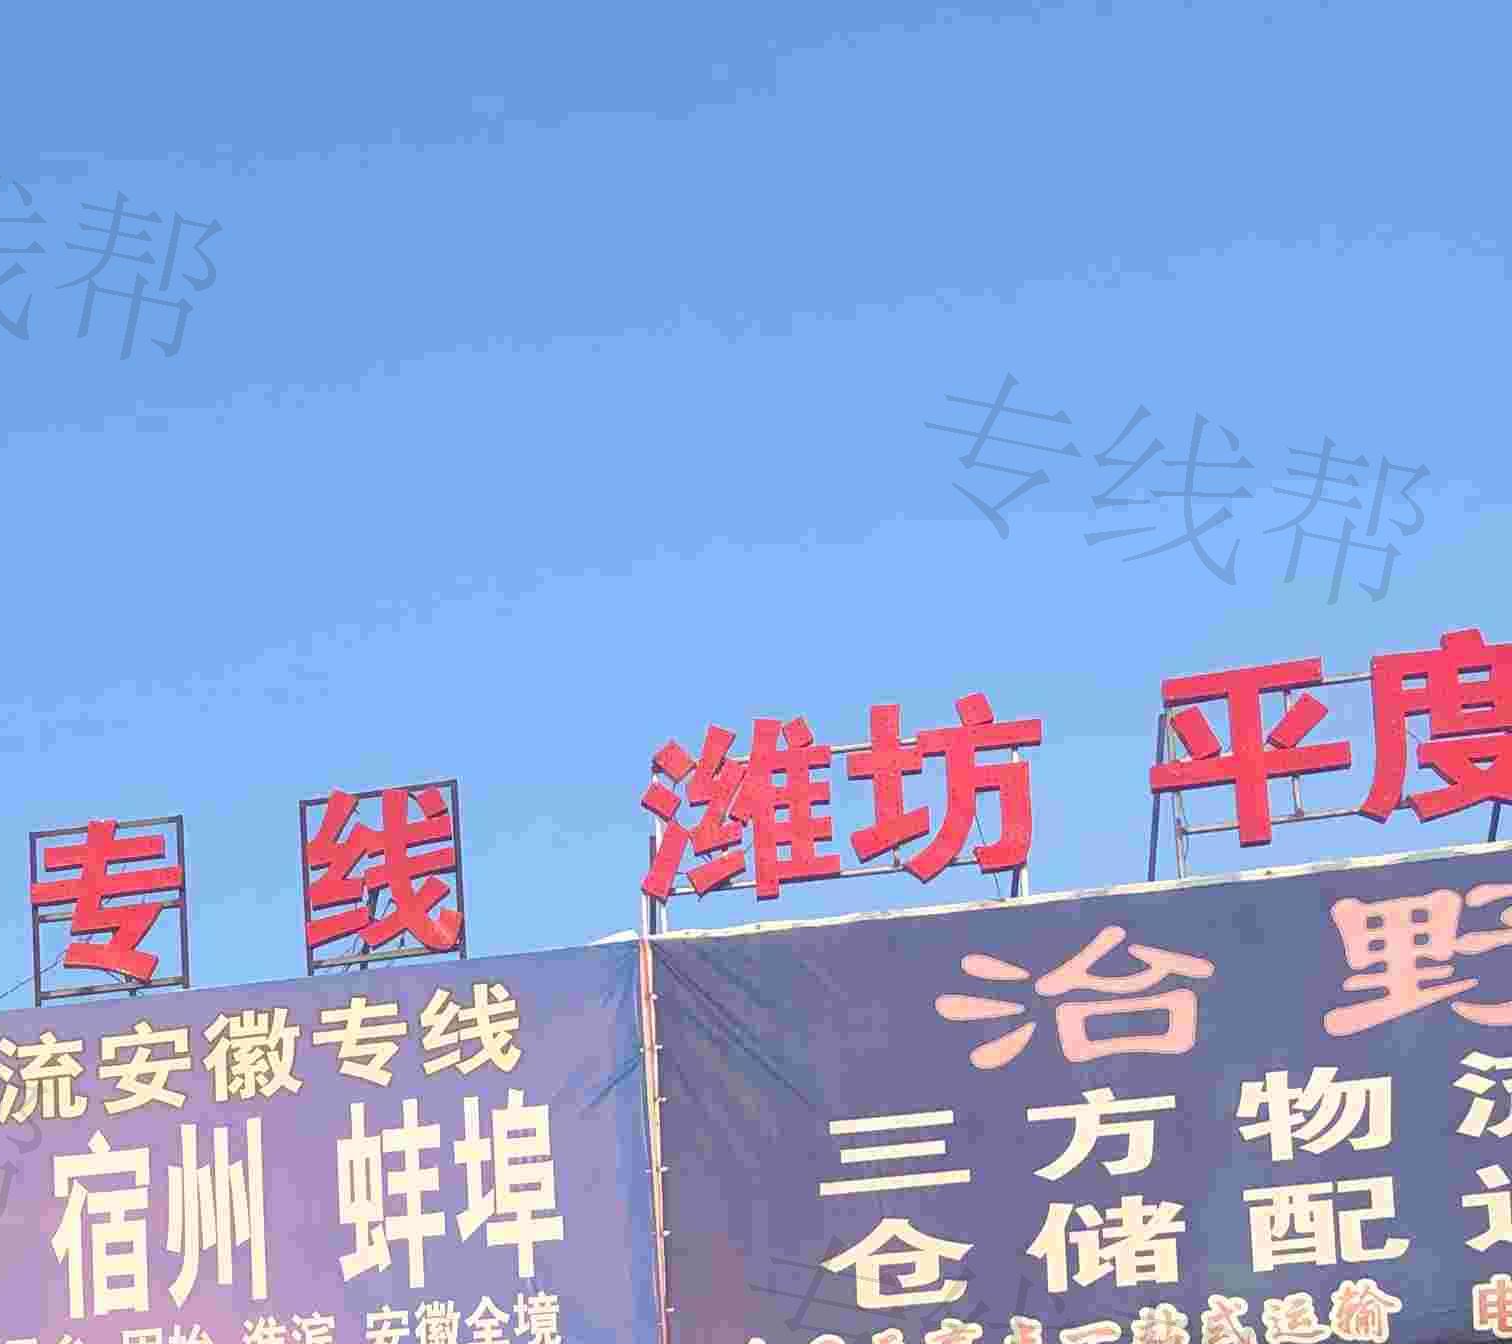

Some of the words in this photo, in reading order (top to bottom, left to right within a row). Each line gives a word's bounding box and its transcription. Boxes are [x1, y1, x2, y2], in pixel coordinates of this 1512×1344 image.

[642, 693, 1042, 900] 潍坊
[1149, 629, 1512, 848] 平度
[51, 1116, 269, 1320] 宿州
[336, 1086, 565, 1289] 蚌埠
